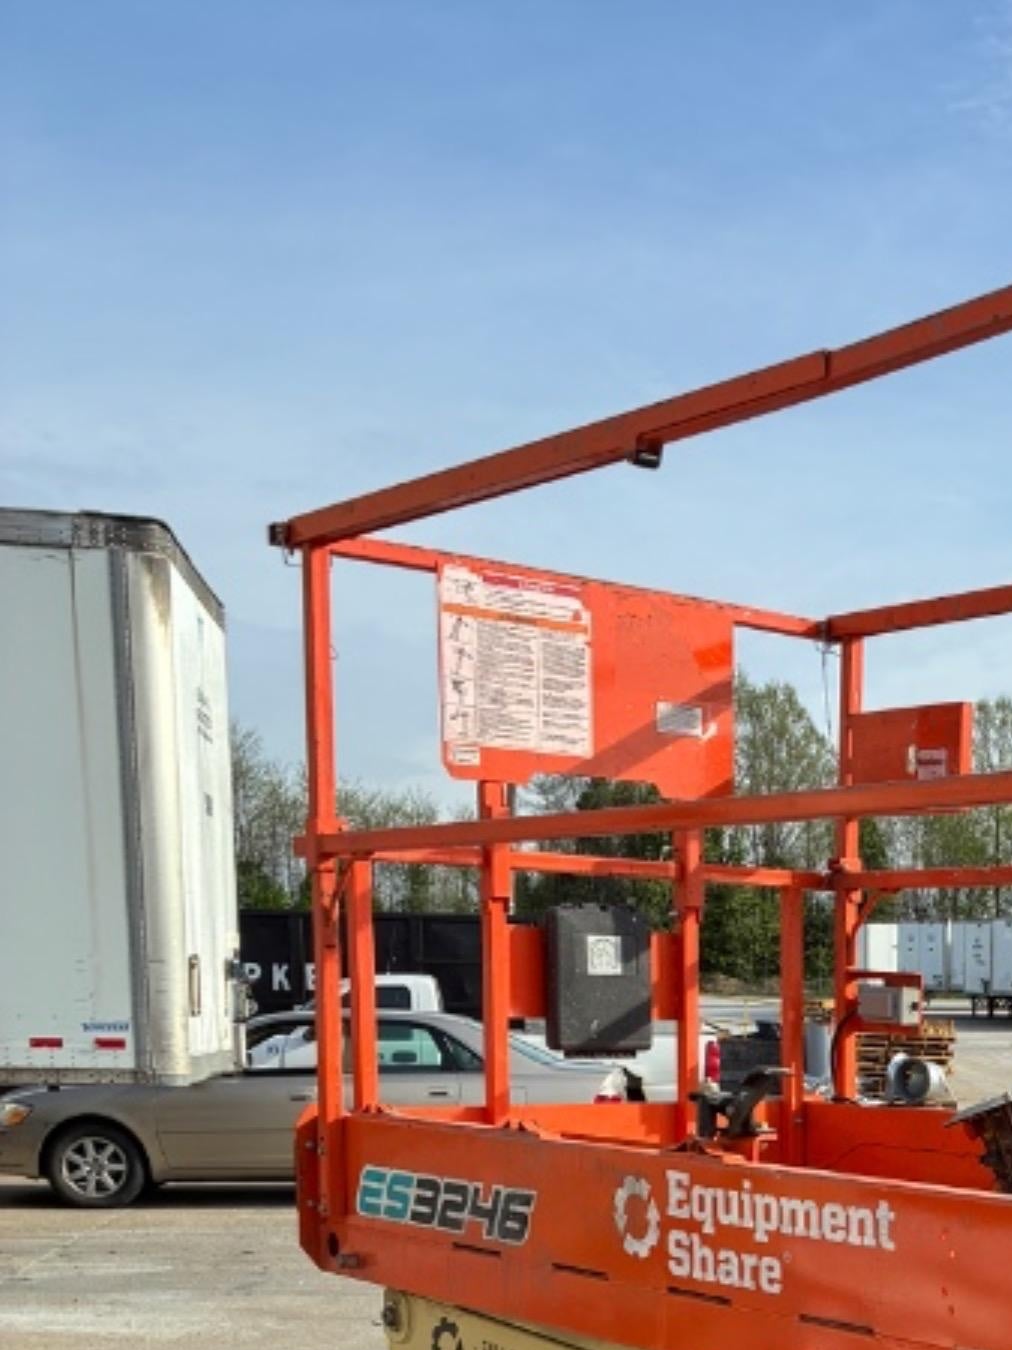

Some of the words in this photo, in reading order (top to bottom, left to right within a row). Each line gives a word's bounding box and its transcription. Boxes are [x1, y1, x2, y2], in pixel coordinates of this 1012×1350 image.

[356, 1164, 537, 1245] ES3246
[666, 1169, 896, 1251] Equipment
[668, 1229, 783, 1295] Share
